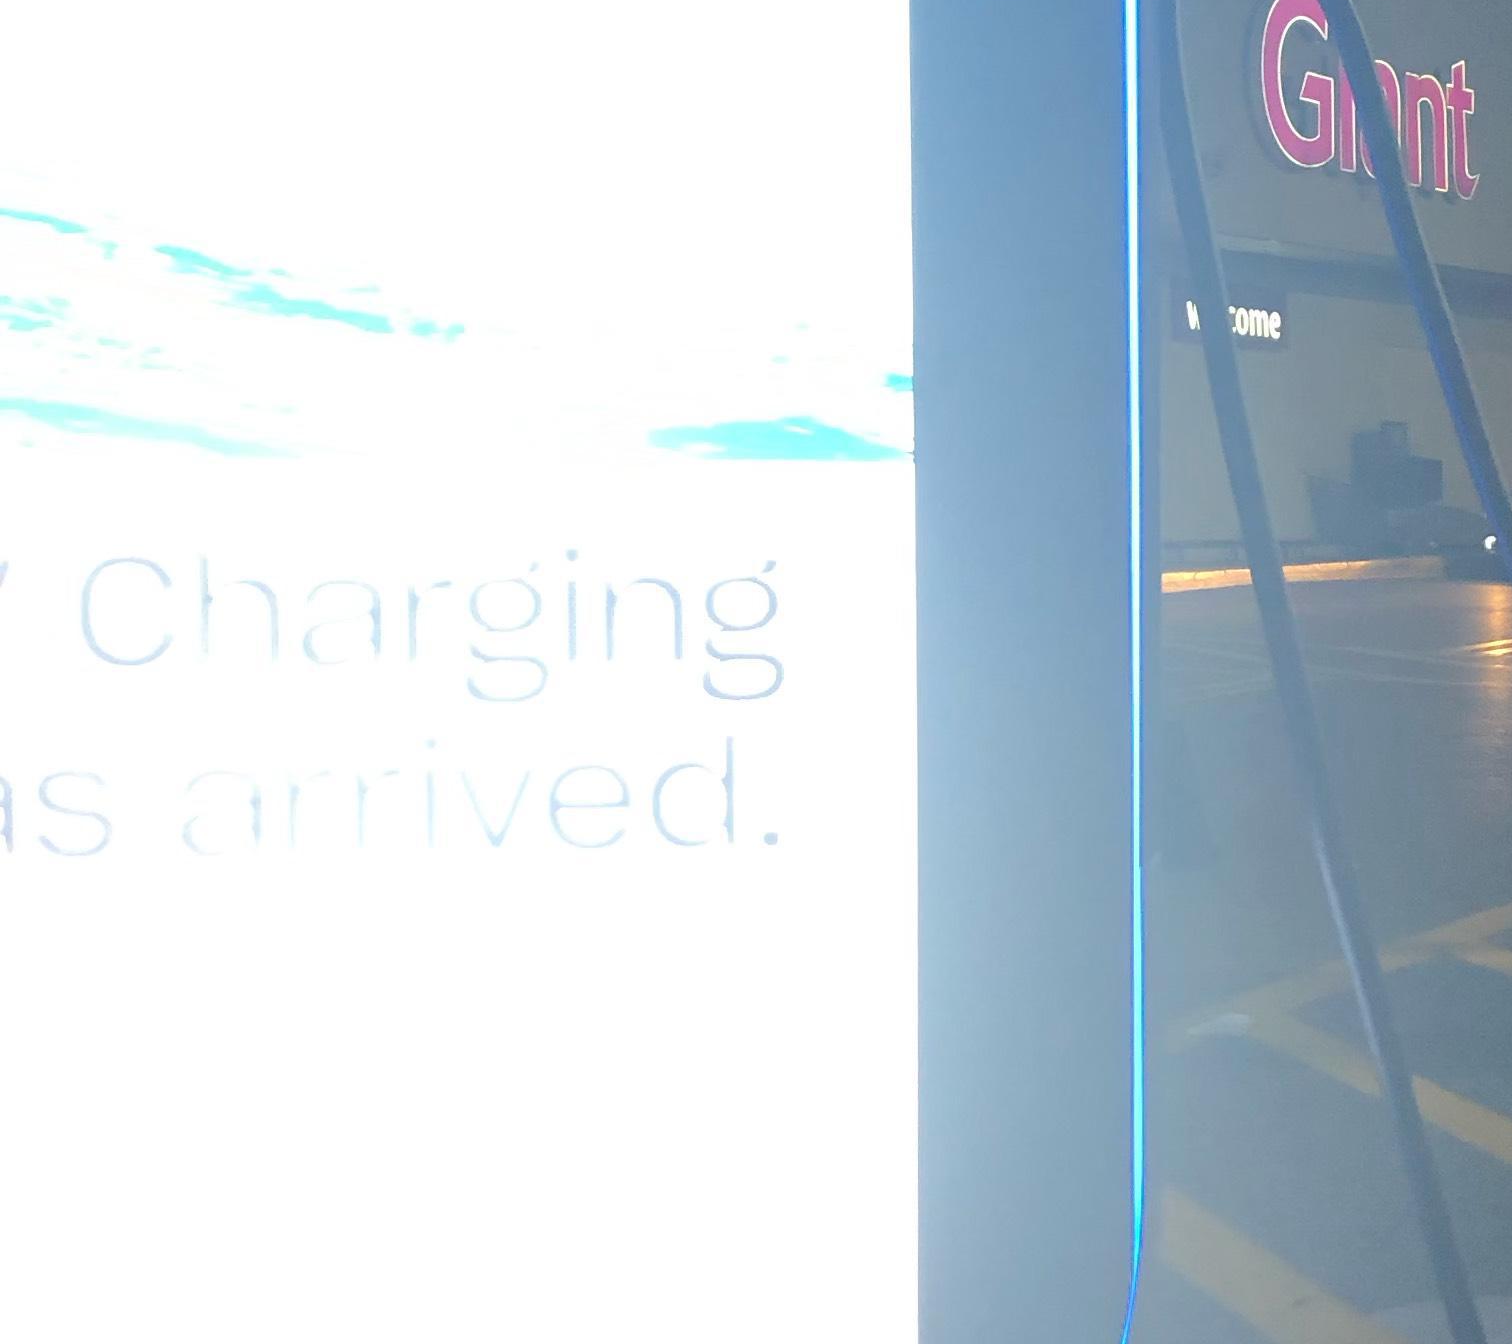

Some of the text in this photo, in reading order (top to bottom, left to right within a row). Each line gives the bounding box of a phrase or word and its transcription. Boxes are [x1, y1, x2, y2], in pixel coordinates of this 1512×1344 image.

[1186, 299, 1281, 340] Wome
[79, 547, 786, 704] Charging
[181, 734, 782, 858] arrived.
